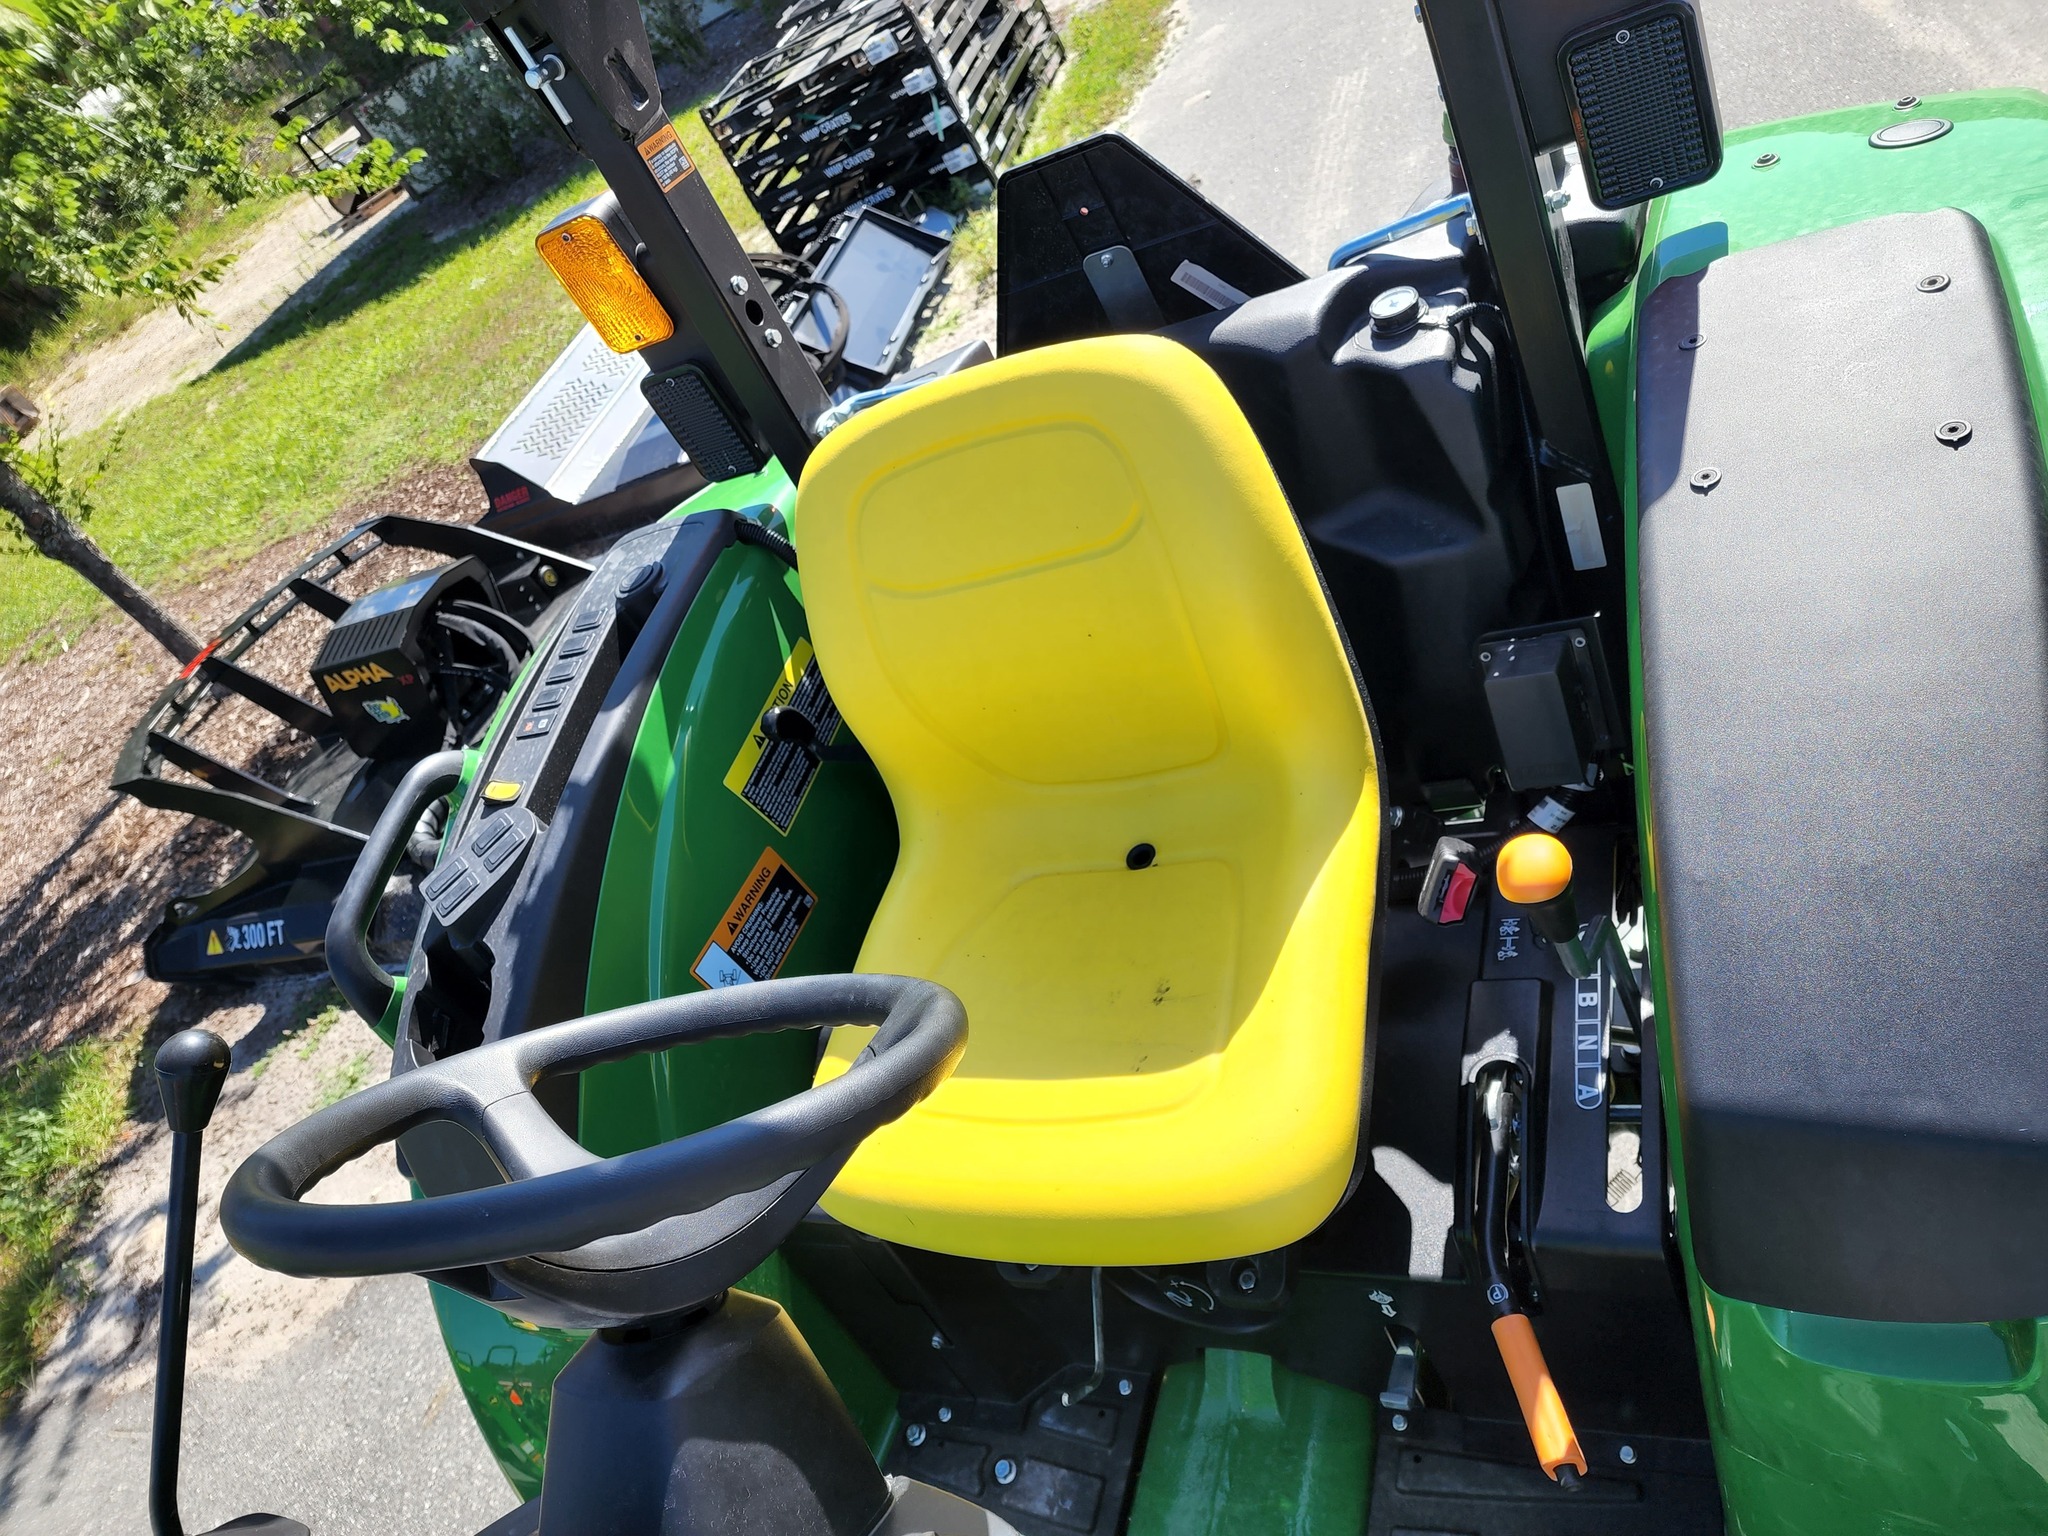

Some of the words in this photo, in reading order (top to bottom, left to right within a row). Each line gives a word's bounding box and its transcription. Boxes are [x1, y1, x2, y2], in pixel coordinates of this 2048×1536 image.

[821, 111, 852, 134] CRATES
[648, 131, 672, 152] WARNING
[844, 147, 875, 171] CRATES
[323, 661, 395, 695] ALPHA
[772, 678, 794, 710] TION
[733, 867, 771, 922] WARNING
[242, 922, 266, 950] 300
[266, 919, 284, 947] FT
[738, 938, 749, 954] Keep
[747, 914, 763, 939] Rollover
[761, 887, 779, 915] Protective
[747, 953, 754, 962] Do
[752, 943, 760, 953] not
[759, 928, 770, 944] jump
[771, 900, 786, 924] machine
[731, 933, 744, 953] AVOID
[742, 931, 760, 958] Structure
[758, 919, 768, 933] fully
[754, 958, 765, 975] When
[764, 932, 780, 959] structure
[778, 918, 789, 933] must
[760, 965, 768, 976] DO
[766, 952, 775, 966] NOT
[774, 942, 782, 953] use
[781, 929, 789, 942] seat
[751, 955, 760, 967] Use
[759, 942, 768, 955] seat
[1578, 992, 1598, 1007] B
[1578, 1035, 1598, 1050] N
[1578, 1084, 1600, 1101] A
